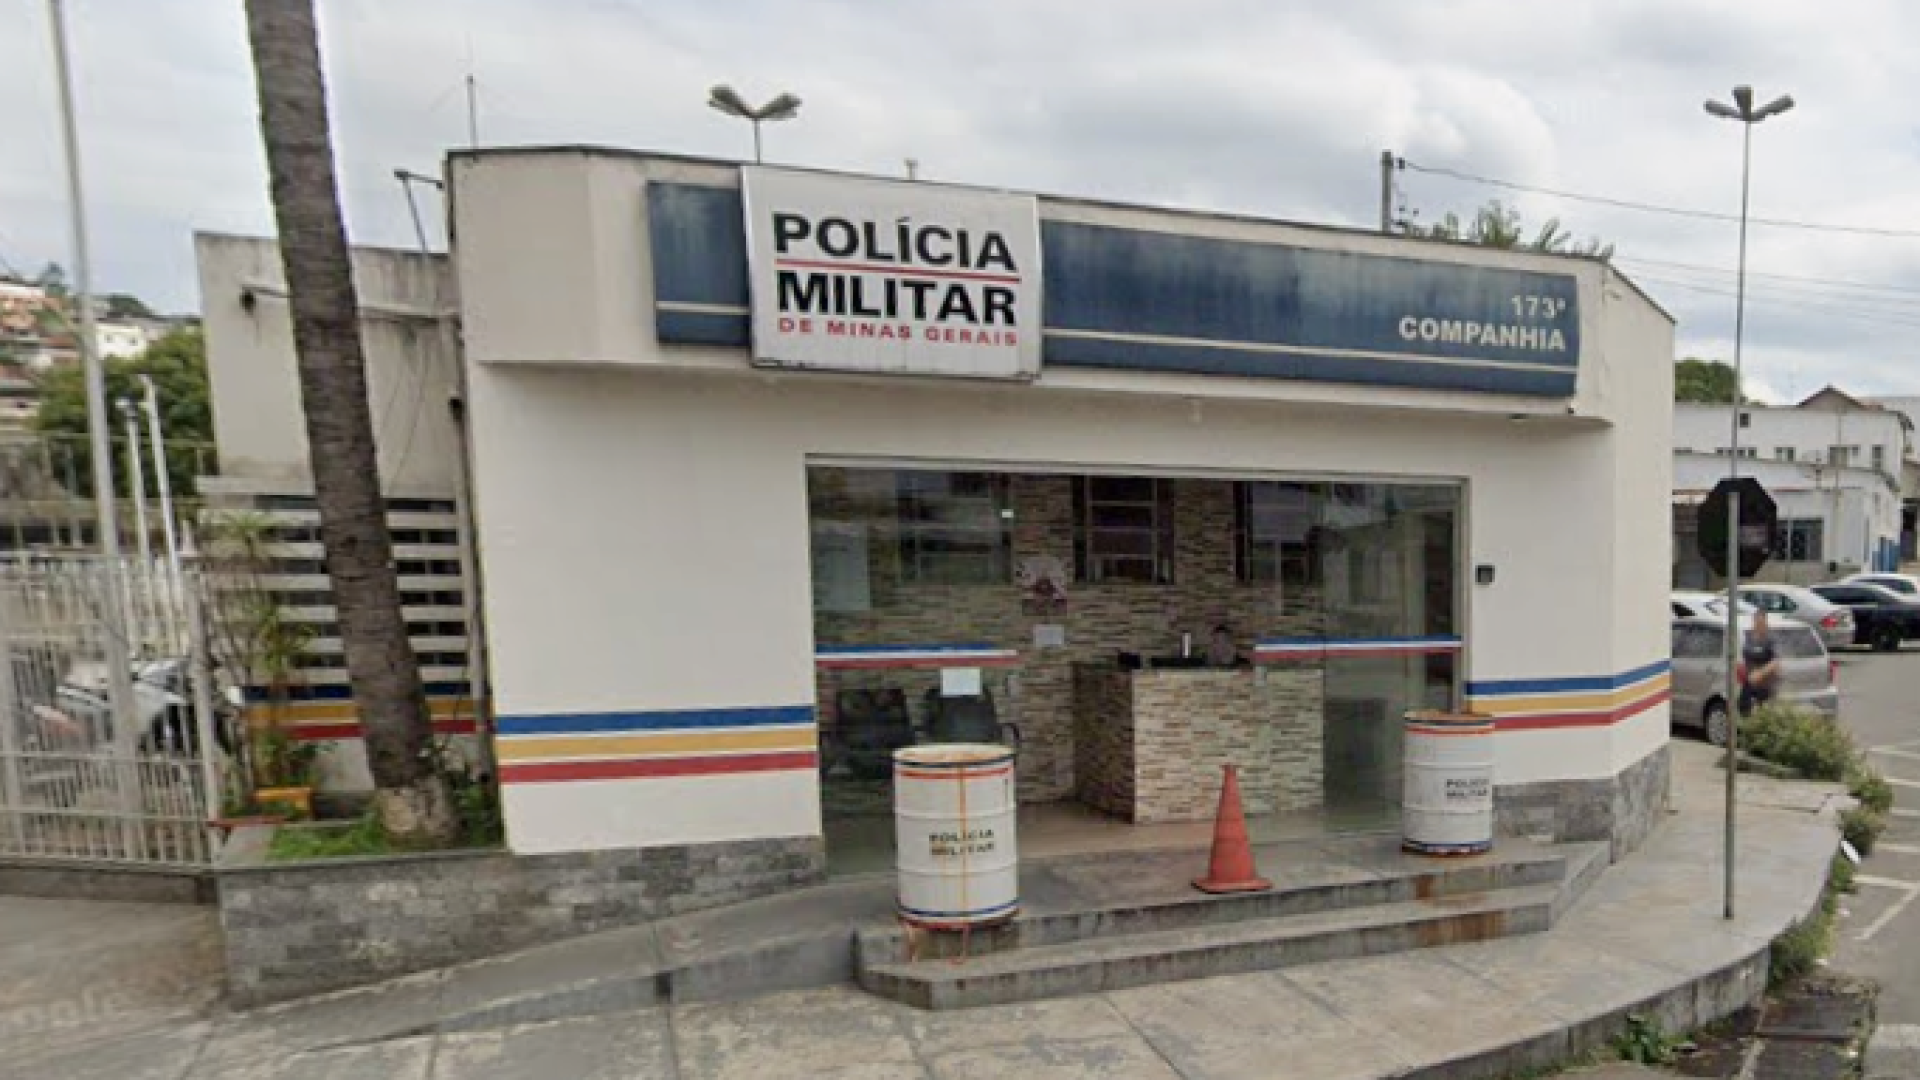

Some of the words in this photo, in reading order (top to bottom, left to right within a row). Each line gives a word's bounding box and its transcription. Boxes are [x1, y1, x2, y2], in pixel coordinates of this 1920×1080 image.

[773, 212, 1017, 271] POLÍCIA
[777, 272, 1017, 325] MILITAR
[778, 317, 812, 334] DE
[827, 321, 912, 339] MINAS
[924, 327, 1017, 346] GERAIS
[1399, 315, 1566, 351] COMPANHIA
